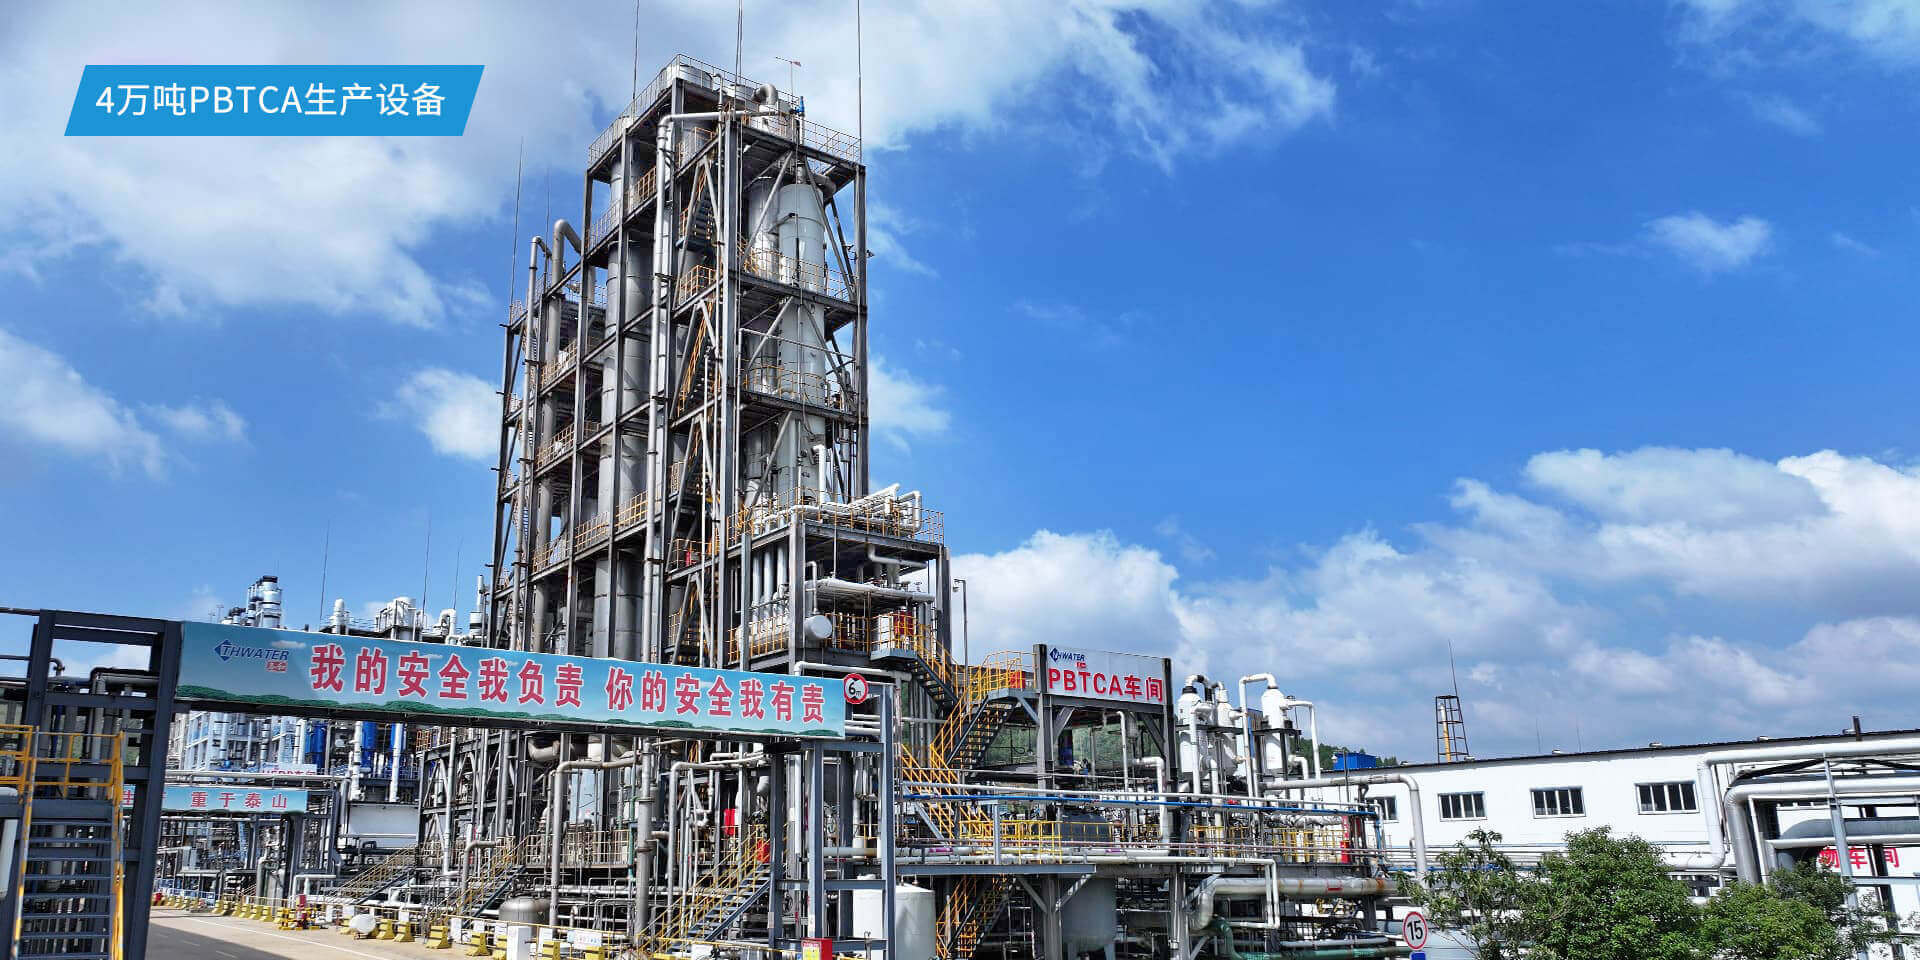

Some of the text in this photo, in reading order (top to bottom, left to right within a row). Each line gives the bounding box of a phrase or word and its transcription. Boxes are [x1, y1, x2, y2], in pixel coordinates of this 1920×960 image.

[221, 645, 290, 661] THWATER
[310, 643, 825, 724] 我的安全我负责 你的安全我有责
[1048, 668, 1163, 702] PBTCA车间
[191, 787, 288, 809] 重于泰山
[1407, 919, 1424, 941] 15
